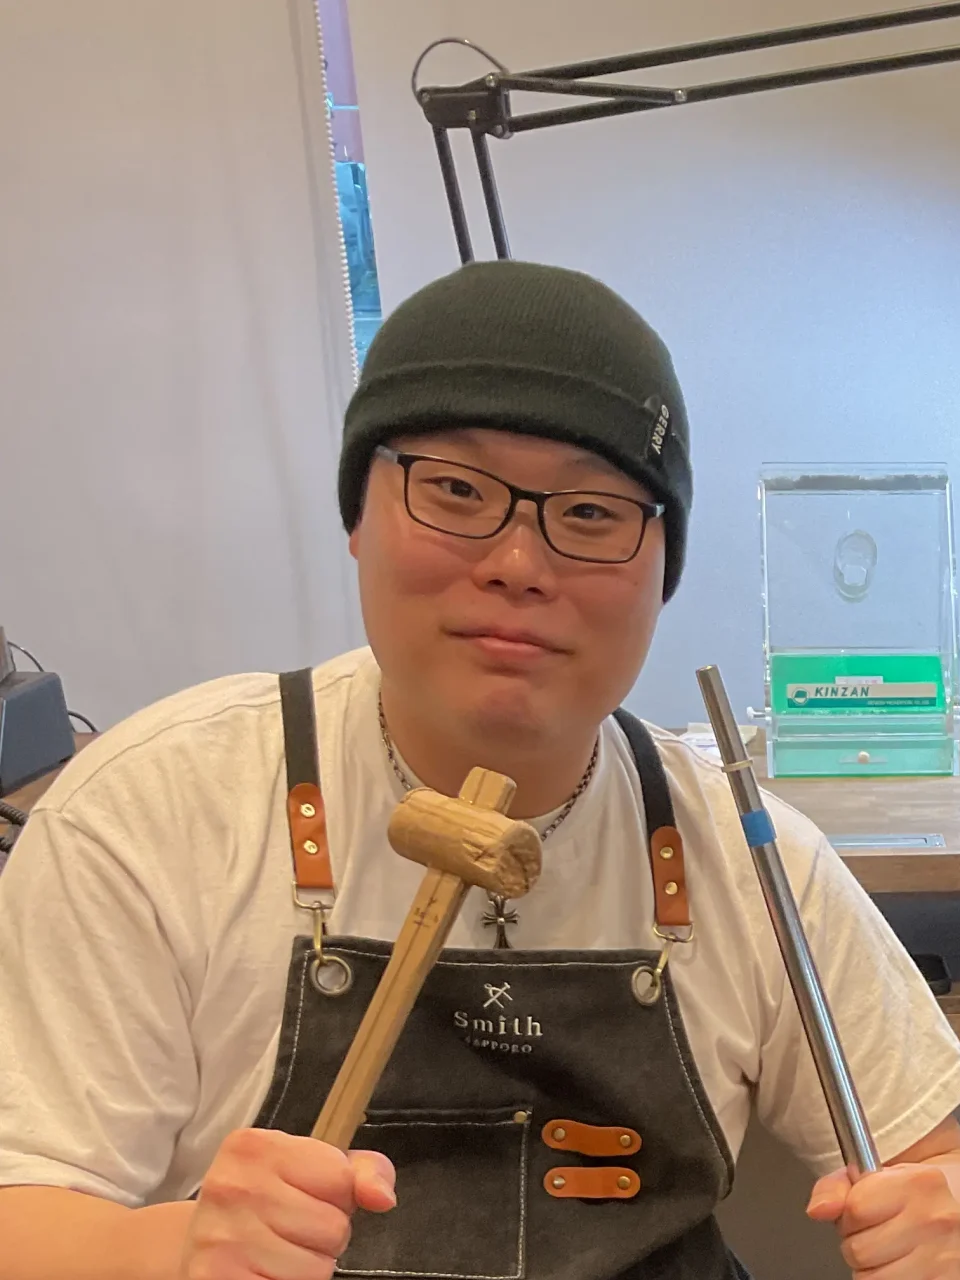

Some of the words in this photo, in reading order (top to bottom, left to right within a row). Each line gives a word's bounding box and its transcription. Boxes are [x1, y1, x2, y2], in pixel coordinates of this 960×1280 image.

[652, 405, 669, 454] GERRY
[814, 686, 870, 697] KINZAN
[454, 1010, 543, 1036] Smith
